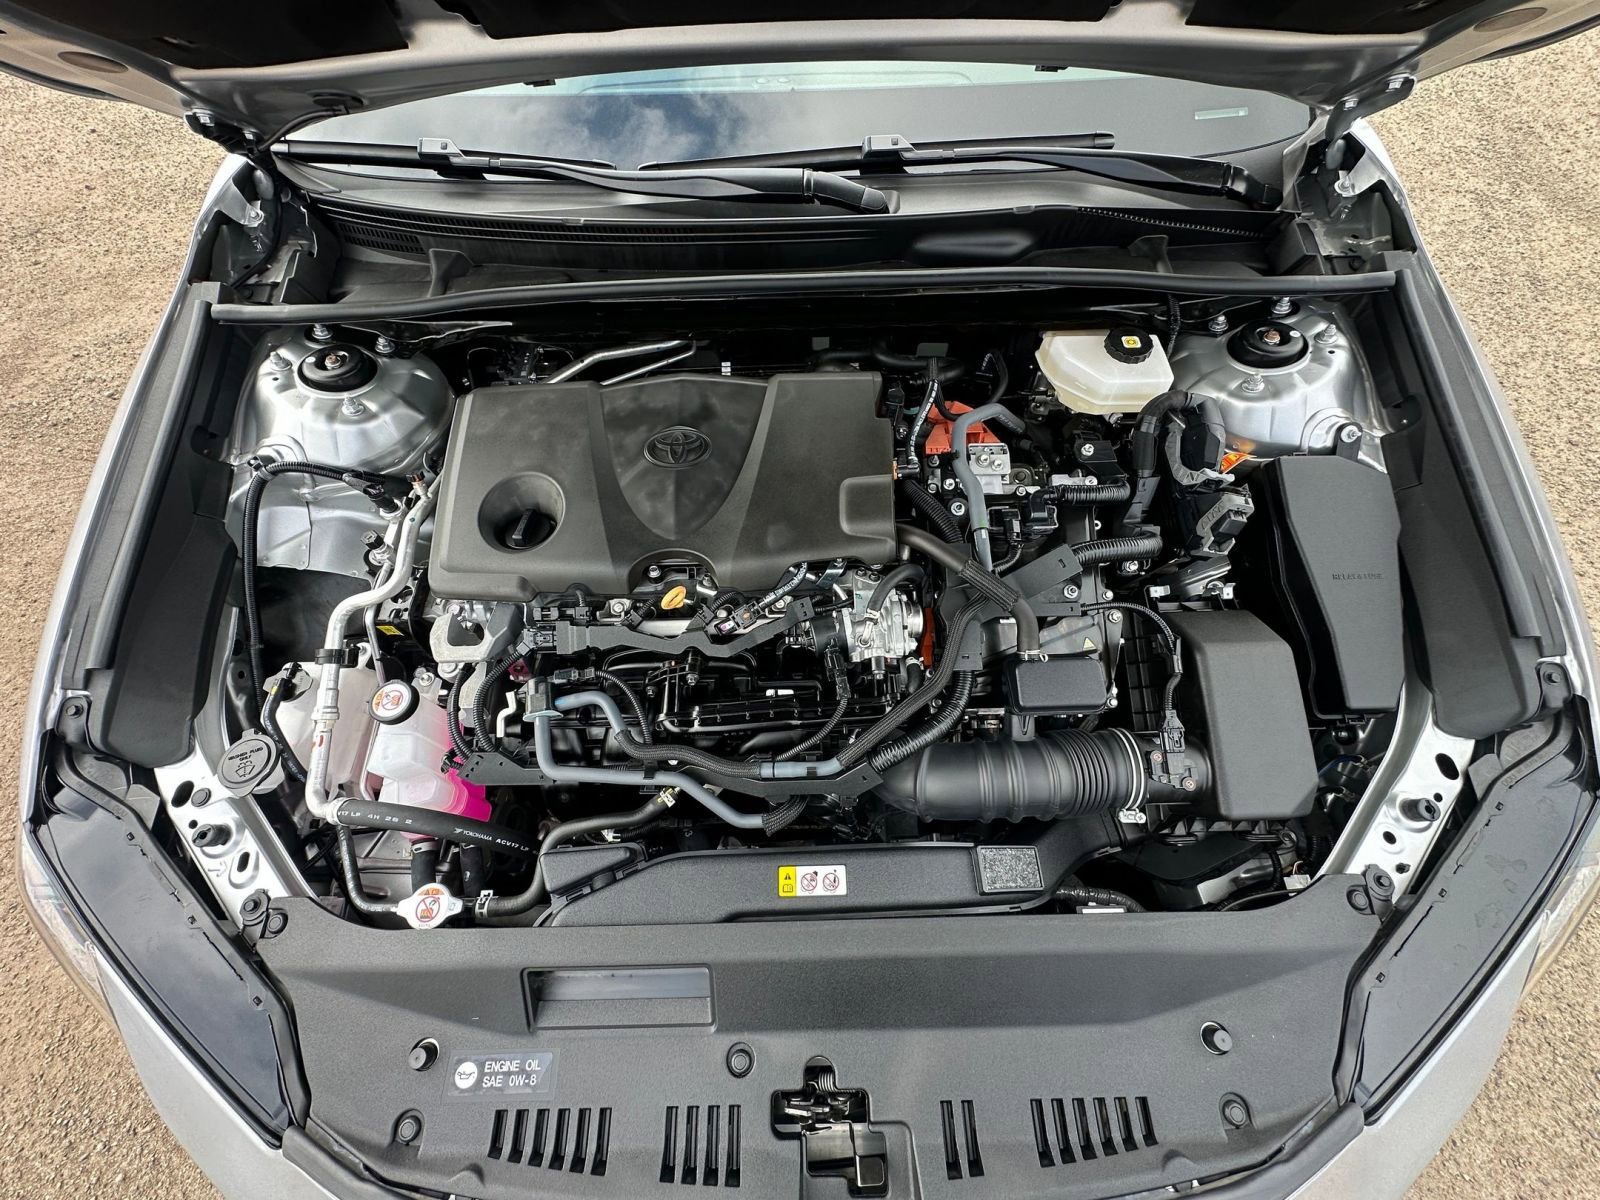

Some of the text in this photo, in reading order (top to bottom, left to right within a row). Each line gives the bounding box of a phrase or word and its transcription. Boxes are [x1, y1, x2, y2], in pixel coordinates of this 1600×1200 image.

[463, 830, 492, 841] YOKOHAMA
[496, 838, 519, 848] ACV17
[484, 1059, 541, 1073] ENGINE OIL
[482, 1074, 537, 1088] SAE 0W-8
